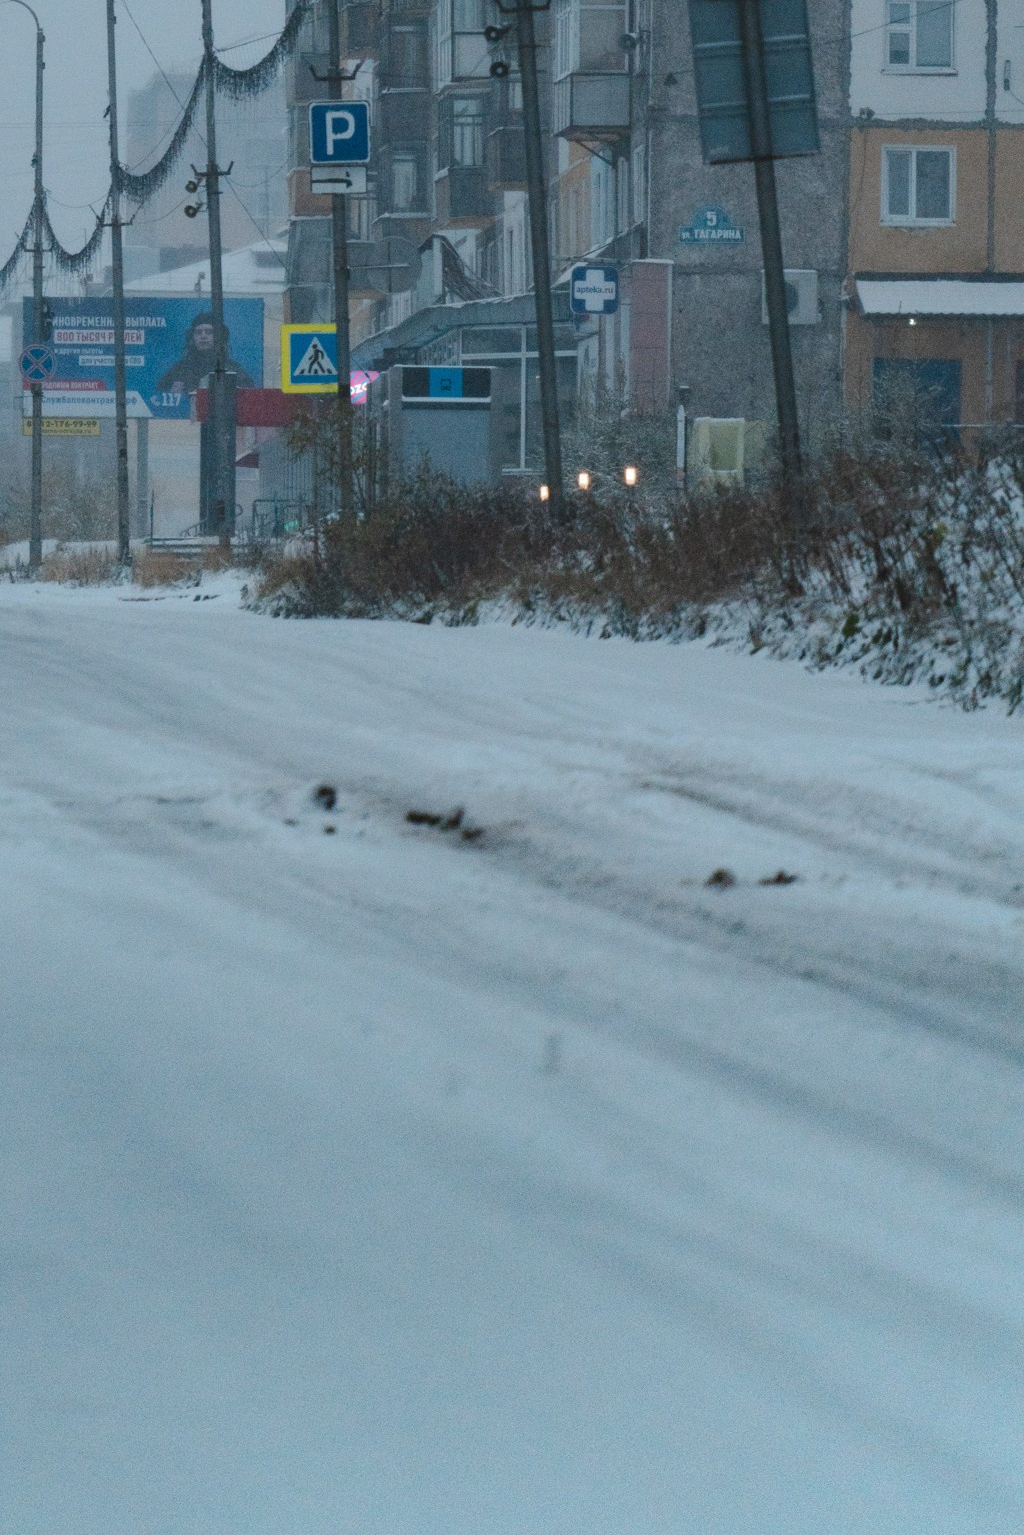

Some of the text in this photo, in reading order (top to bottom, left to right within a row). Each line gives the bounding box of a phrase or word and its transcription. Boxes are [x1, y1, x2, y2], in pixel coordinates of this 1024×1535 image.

[325, 110, 356, 156] P
[706, 211, 717, 227] 5
[694, 228, 742, 240] ГАГАРИНА
[576, 286, 614, 295] apteka.ru
[125, 316, 167, 328] ВЫПЛАТА
[56, 330, 143, 343] 800 ТЫСЯЧ РЛЕЙ
[161, 393, 181, 407] 117
